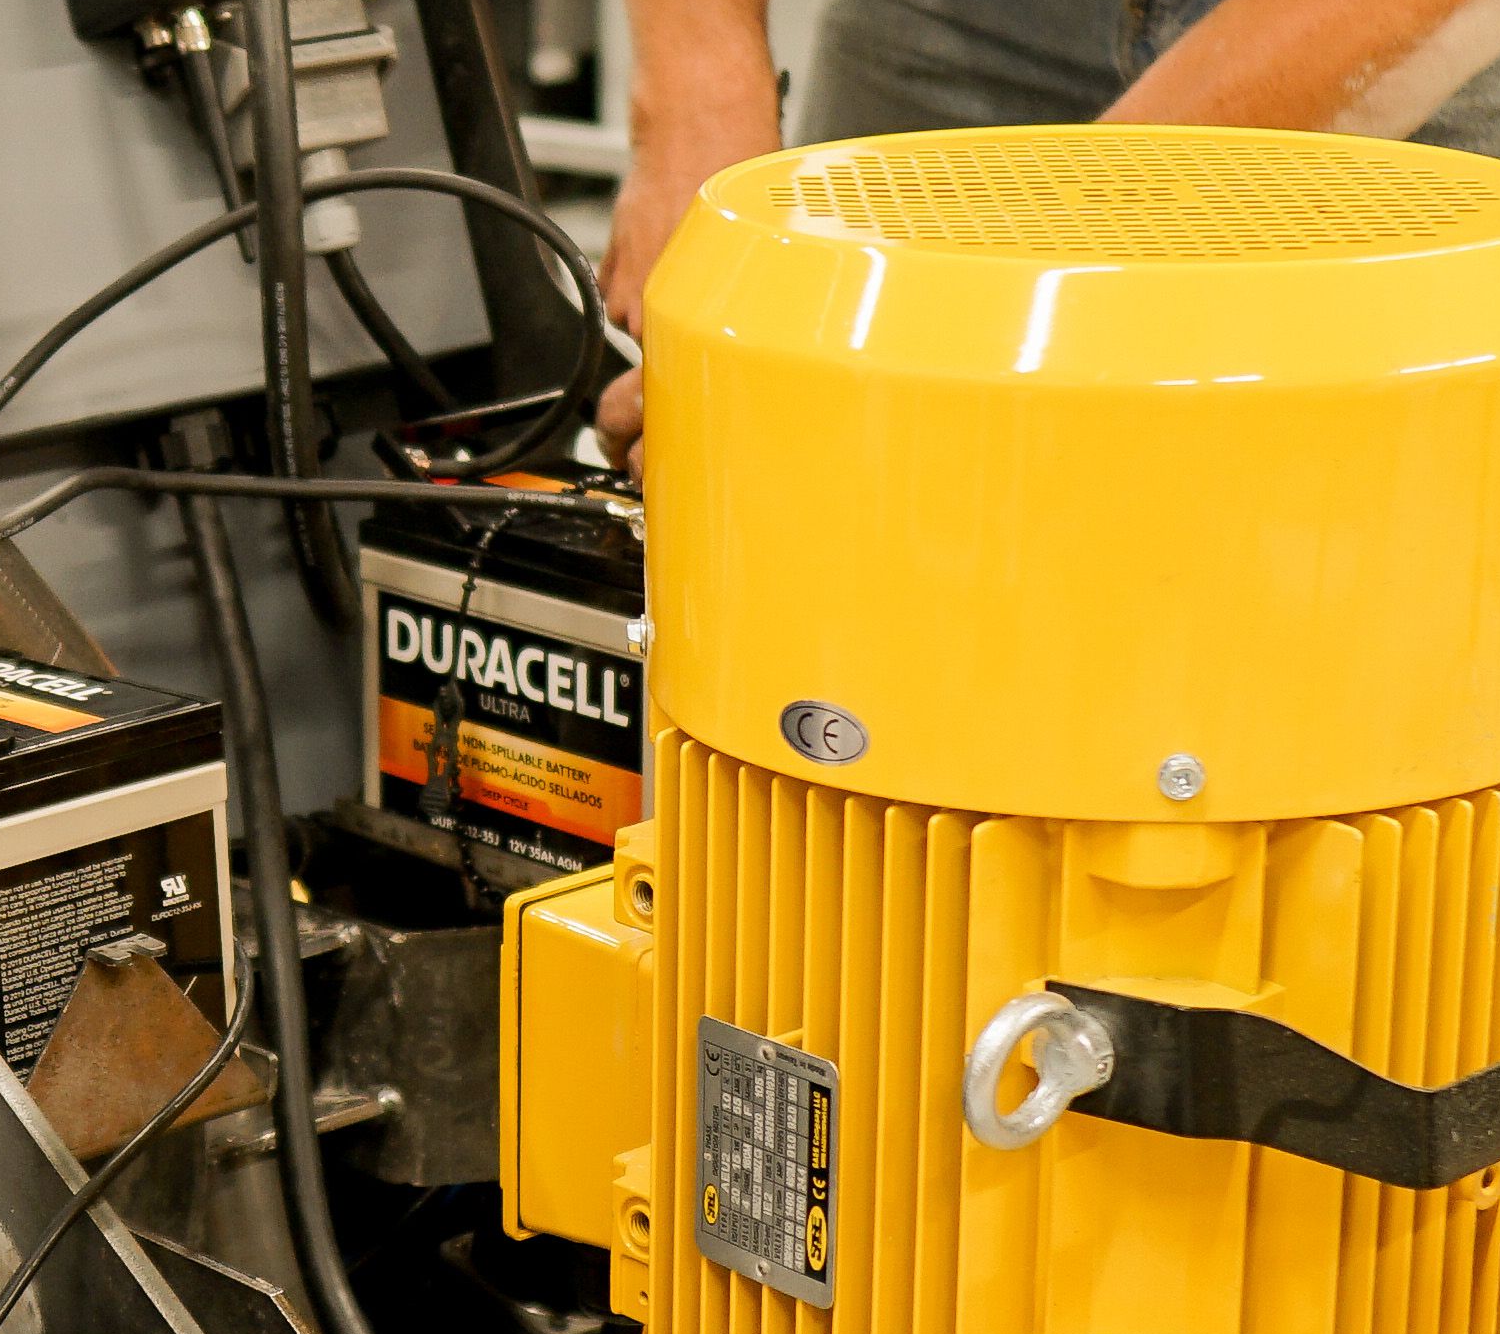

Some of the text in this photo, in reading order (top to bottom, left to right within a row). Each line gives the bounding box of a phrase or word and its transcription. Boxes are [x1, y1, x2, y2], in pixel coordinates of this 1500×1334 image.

[479, 693, 532, 724] ULTRA
[463, 735, 544, 770] NON-SPILLABLE
[546, 760, 592, 785] BATTERY
[549, 782, 603, 809] SELLADOS
[508, 839, 528, 855] 12V
[529, 845, 556, 865] 35Ah
[557, 855, 584, 872] AGM
[753, 1109, 763, 1142] 2020
